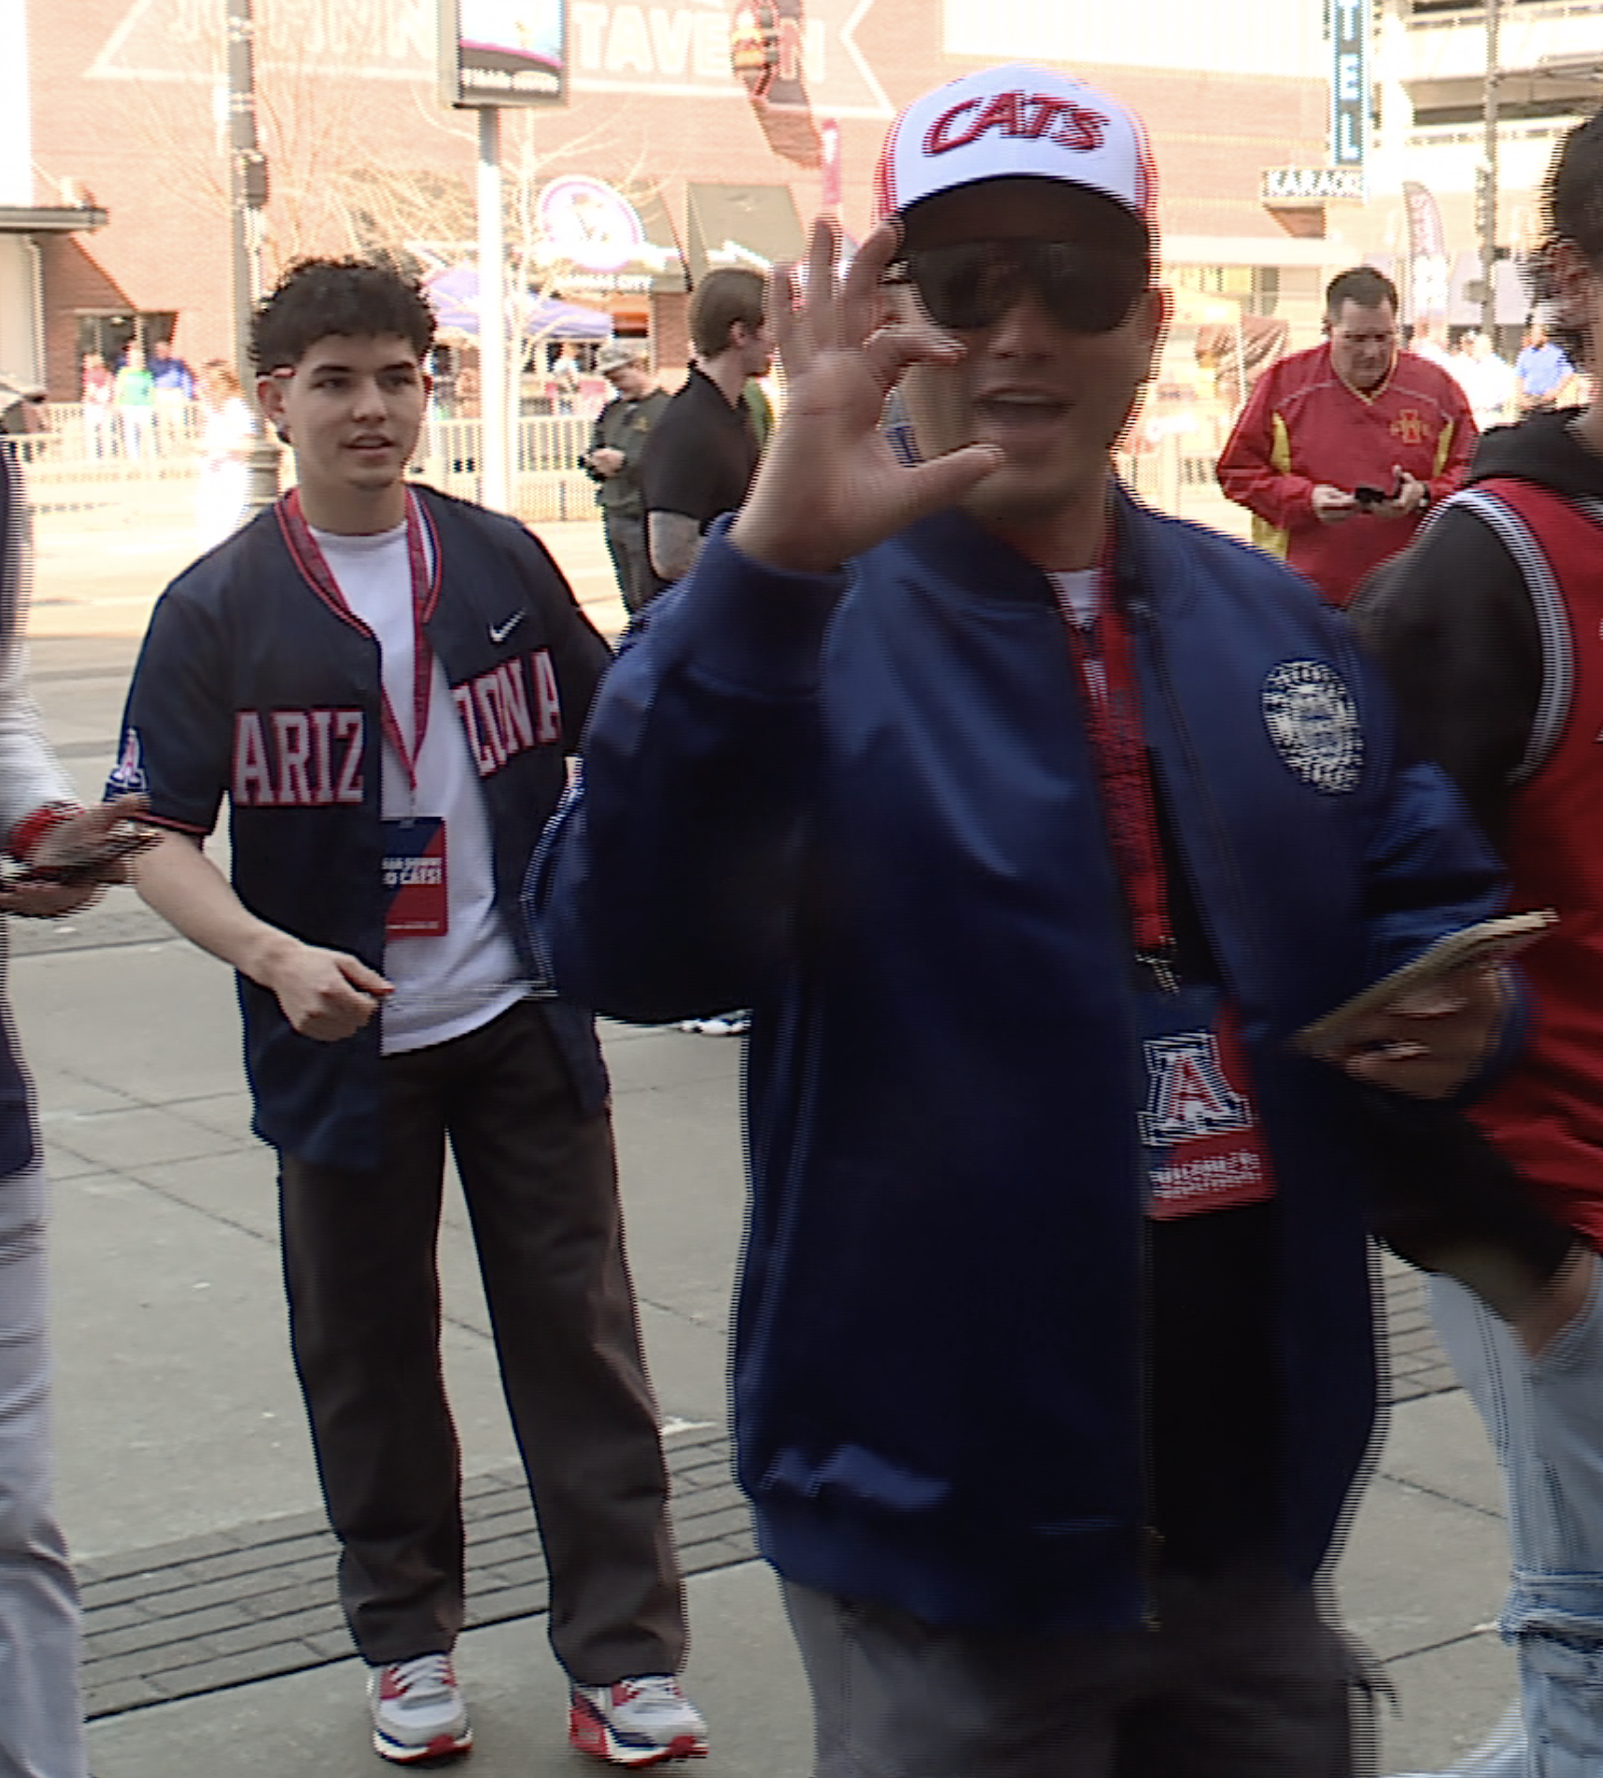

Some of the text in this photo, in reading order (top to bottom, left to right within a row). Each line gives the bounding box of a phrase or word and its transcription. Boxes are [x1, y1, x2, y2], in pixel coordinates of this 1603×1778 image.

[570, 5, 825, 83] TAVEN
[921, 89, 1108, 156] CATS
[233, 707, 364, 806] ARIZ
[1137, 1032, 1251, 1146] A
